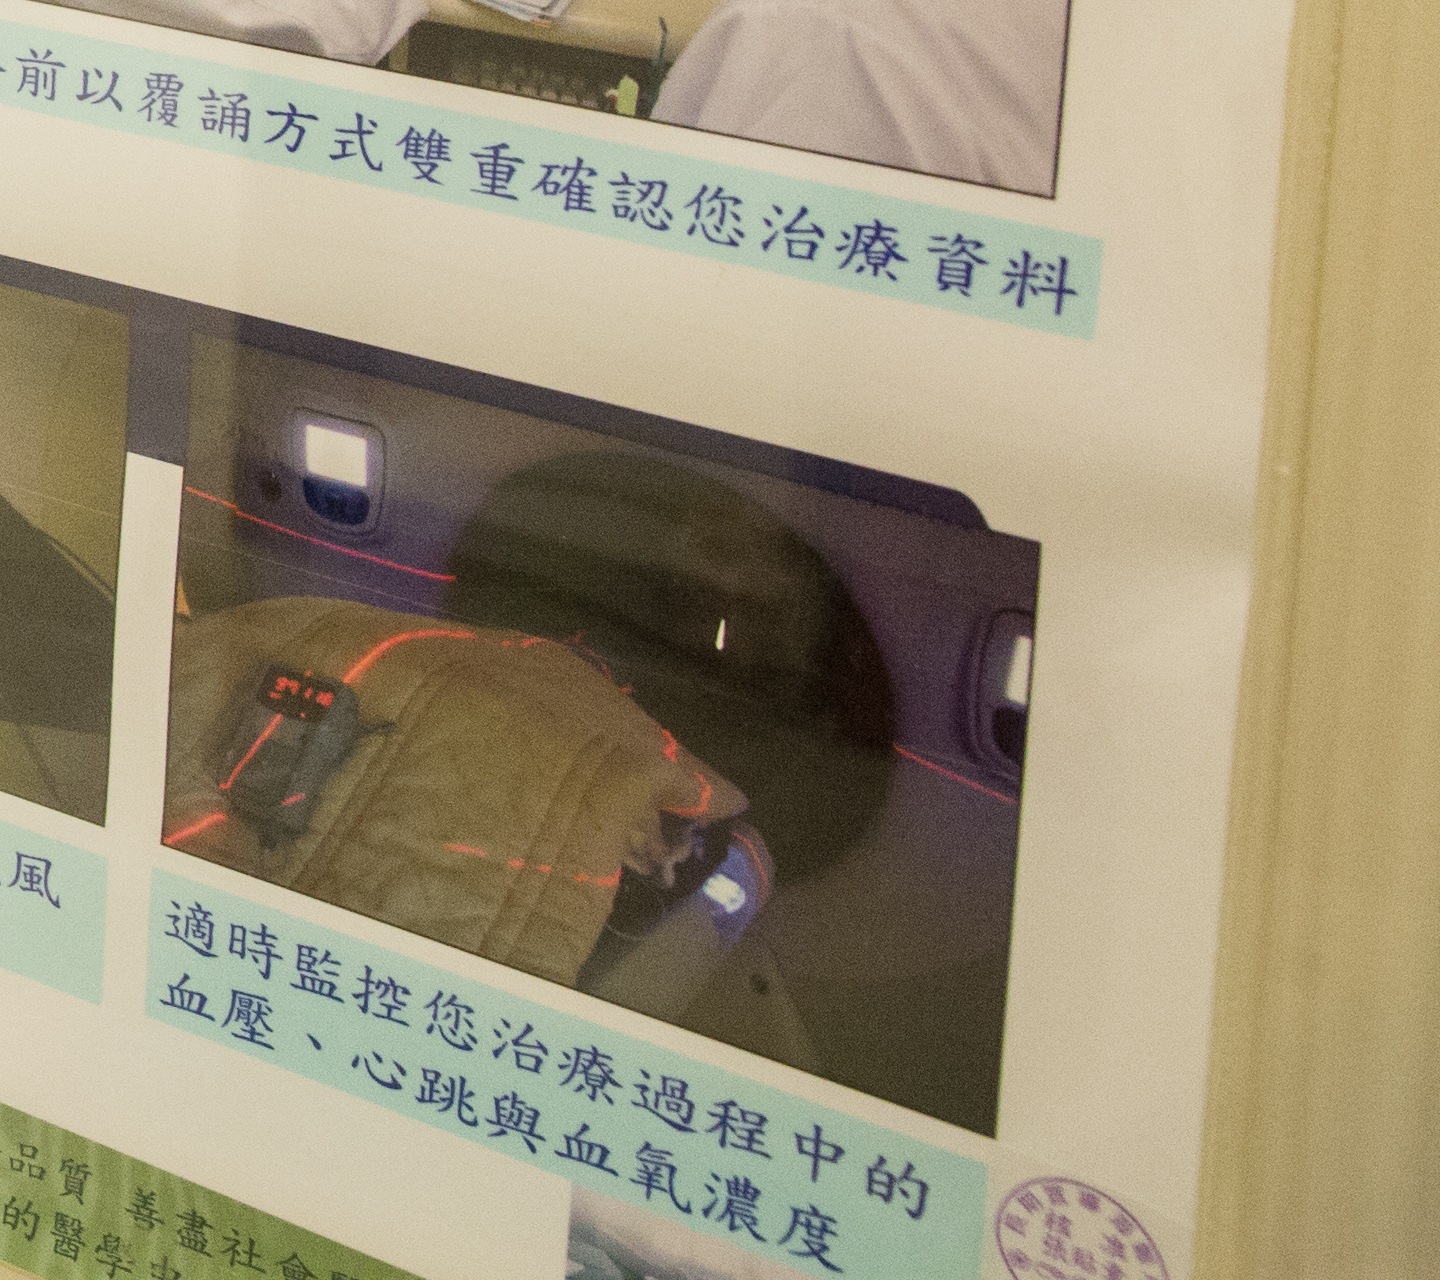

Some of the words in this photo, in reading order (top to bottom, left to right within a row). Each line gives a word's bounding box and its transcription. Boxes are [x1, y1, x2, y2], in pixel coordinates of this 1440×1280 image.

[159, 973, 844, 1273] 血壓、心跳與血氧濃度
[162, 900, 931, 1221] 適時監控您治療過程中的
[125, 1187, 361, 1280] 善盡社會
